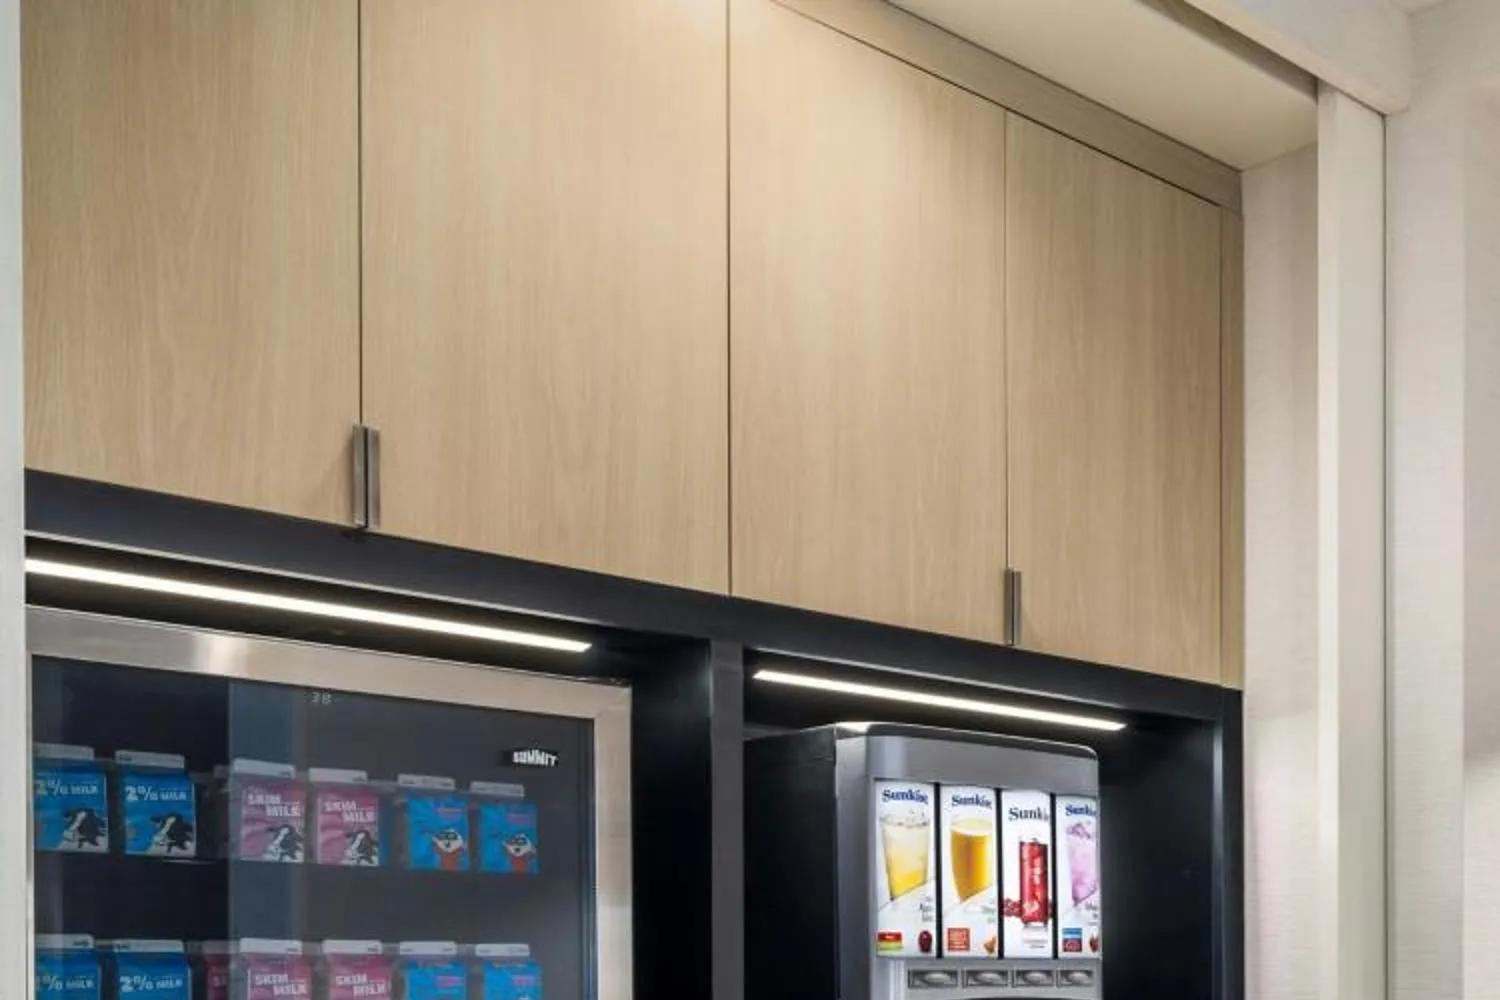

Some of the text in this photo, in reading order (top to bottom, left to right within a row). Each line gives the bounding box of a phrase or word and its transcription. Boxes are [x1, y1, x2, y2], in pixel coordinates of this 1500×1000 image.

[513, 749, 558, 767] SUMMIT
[124, 785, 158, 801] 2%
[119, 974, 155, 993] 2%
